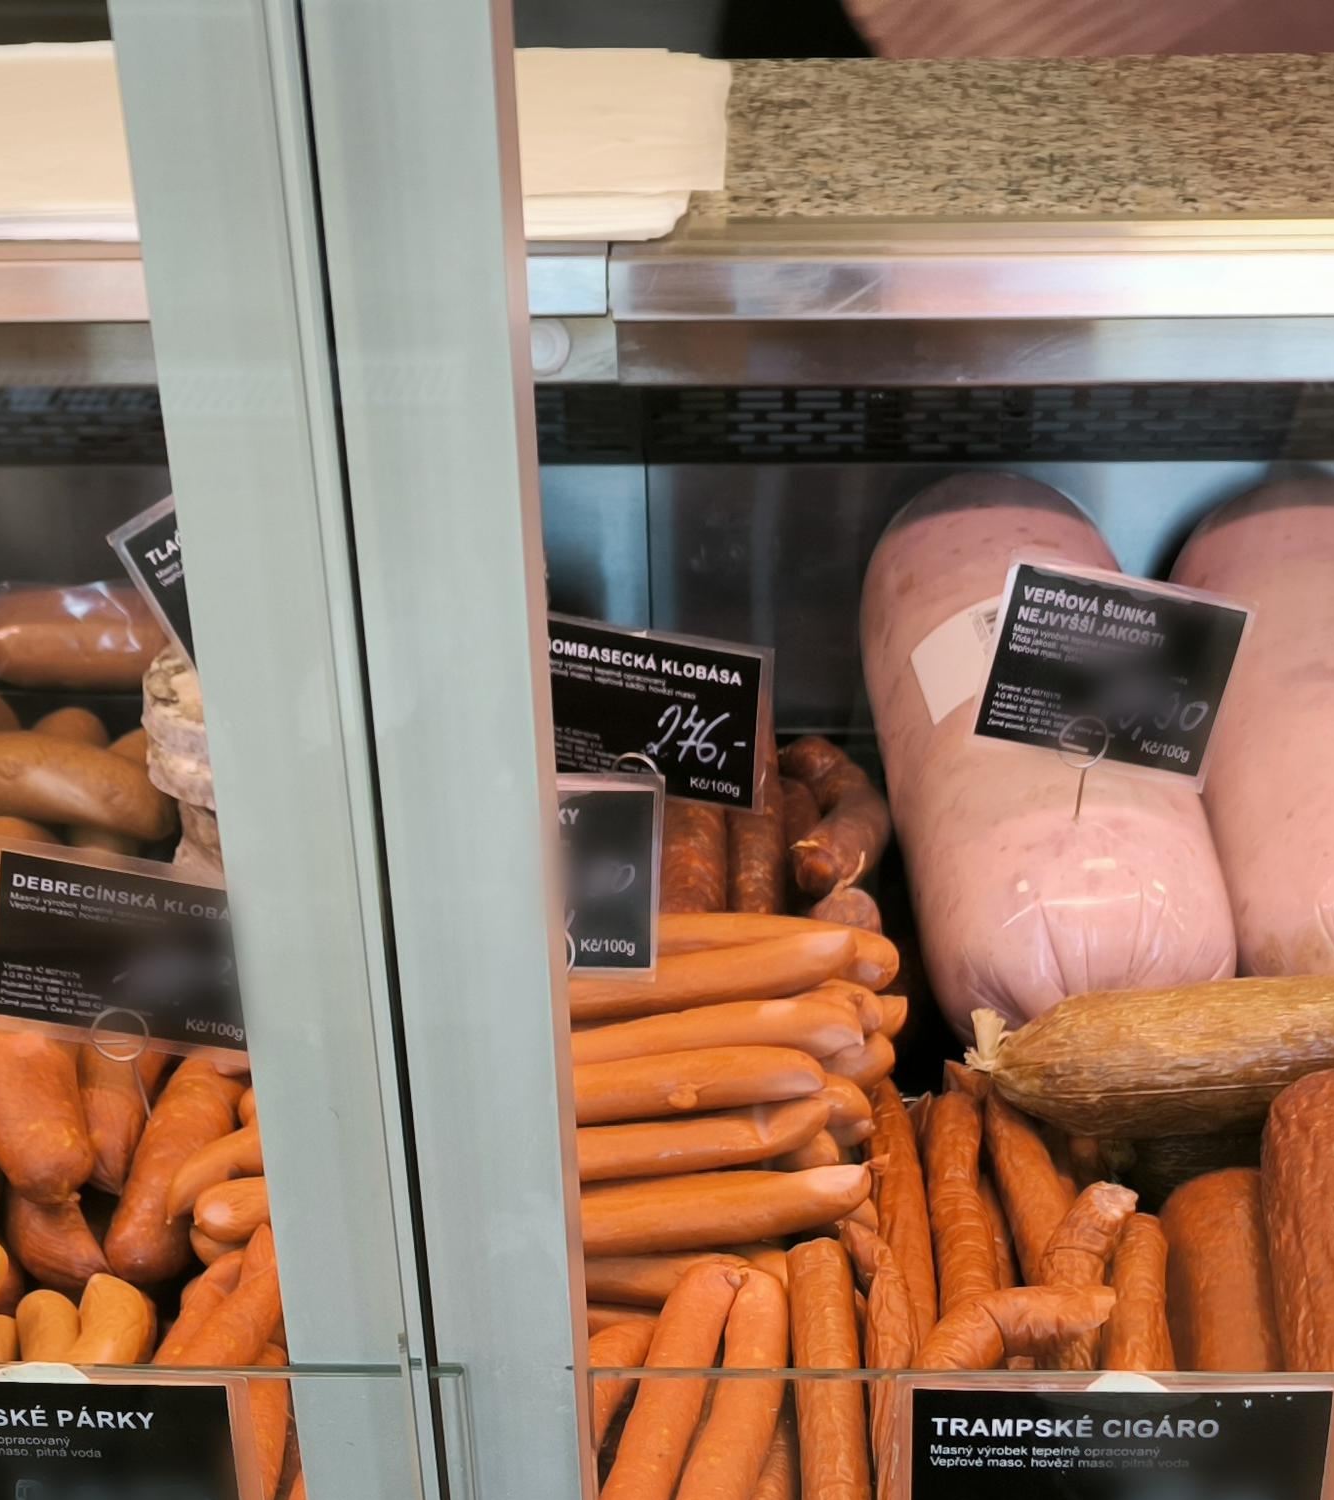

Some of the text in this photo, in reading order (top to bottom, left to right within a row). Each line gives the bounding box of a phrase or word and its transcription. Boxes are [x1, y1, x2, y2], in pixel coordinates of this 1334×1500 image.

[1022, 584, 1158, 627] VEPŘOVÁ ŠUNKA
[1016, 605, 1095, 635] NEJVYŠŠÍ
[1097, 622, 1166, 648] JAKOSTI
[548, 639, 656, 671] OMBASECKÁ
[661, 658, 742, 687] KLOBÁSA
[1140, 738, 1190, 764] Kč/100g
[689, 776, 740, 798] Kč/100g
[12, 873, 158, 911] DEBRECÍNSKÁ
[580, 938, 636, 956] Kč/100g
[185, 1018, 244, 1041] Kč/100g
[57, 1405, 155, 1430] PÁRKY
[931, 1414, 1219, 1438] TRAMPSKÉ CIGÁRO
[71, 1448, 102, 1458] voda
[930, 1444, 1160, 1458] Masný výrobek tepelně opracovaný
[930, 1456, 983, 1469] Vepřové
[1031, 1456, 1073, 1468] hovězí
